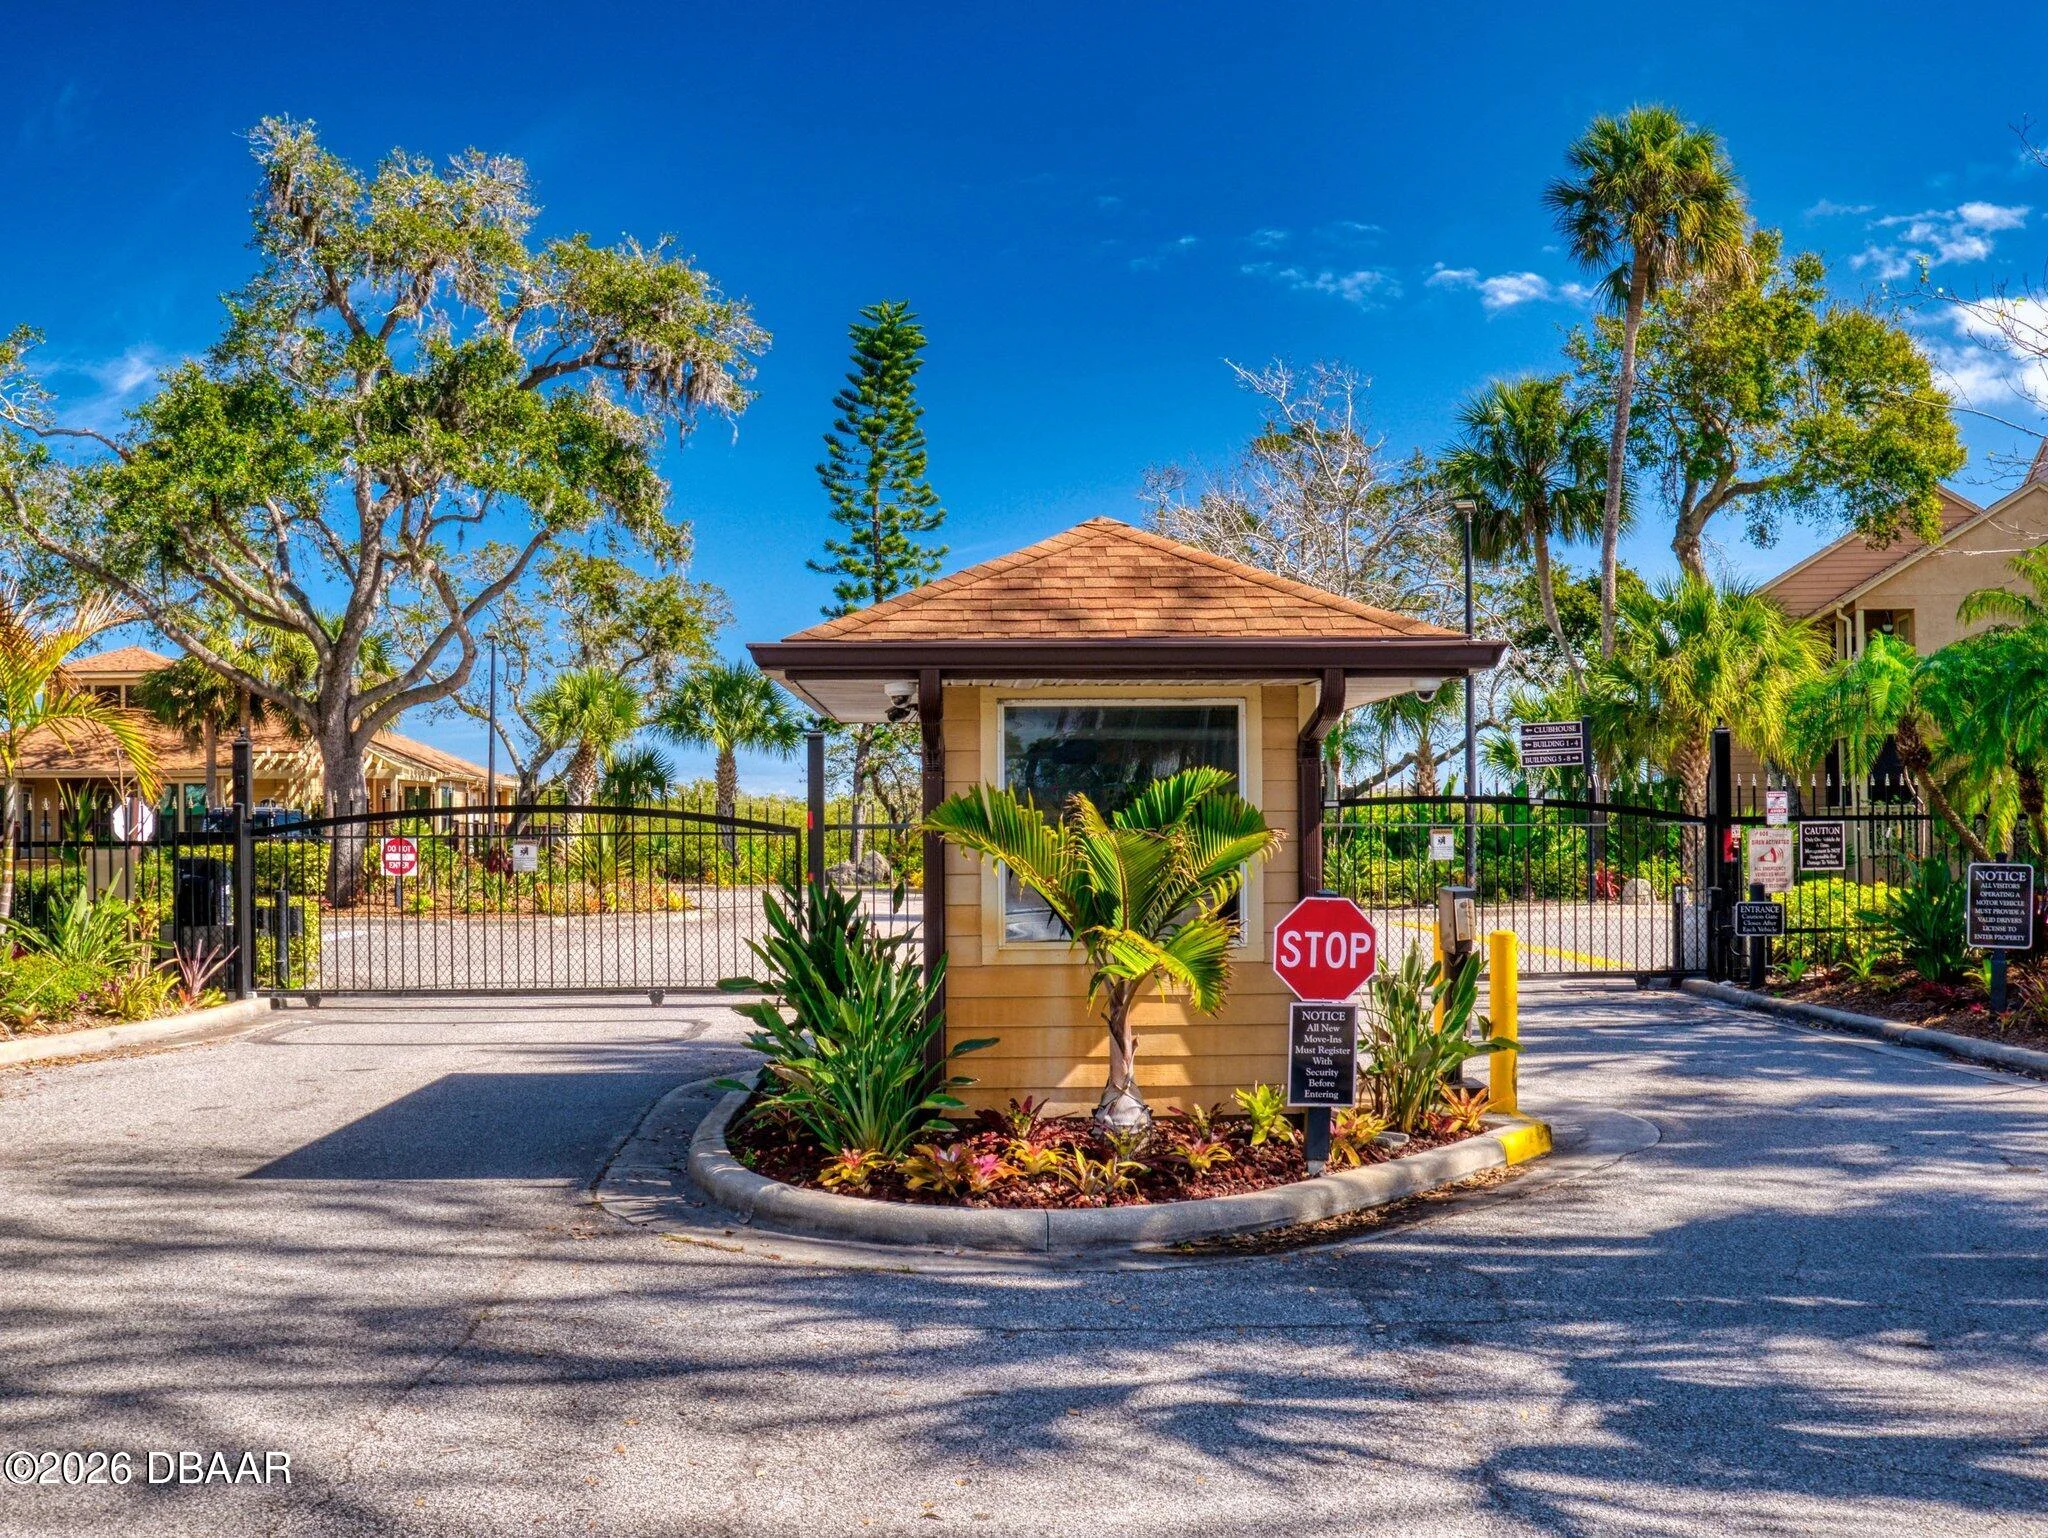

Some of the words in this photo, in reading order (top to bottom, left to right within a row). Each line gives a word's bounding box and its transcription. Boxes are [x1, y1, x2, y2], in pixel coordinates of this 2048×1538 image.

[1804, 826, 1840, 835] CAUTION
[1975, 871, 2026, 881] NOTICE
[1280, 930, 1371, 969] STOP
[1302, 1011, 1345, 1021] NOTICE
[1307, 1024, 1320, 1032] All
[1321, 1024, 1340, 1032] New
[1304, 1035, 1342, 1044] Move-Ins
[1295, 1046, 1316, 1054] Must
[1318, 1046, 1350, 1056] Register
[1313, 1057, 1332, 1065] With
[1306, 1068, 1338, 1078] Security
[1309, 1079, 1335, 1087] Before
[1304, 1090, 1338, 1099] Entering
